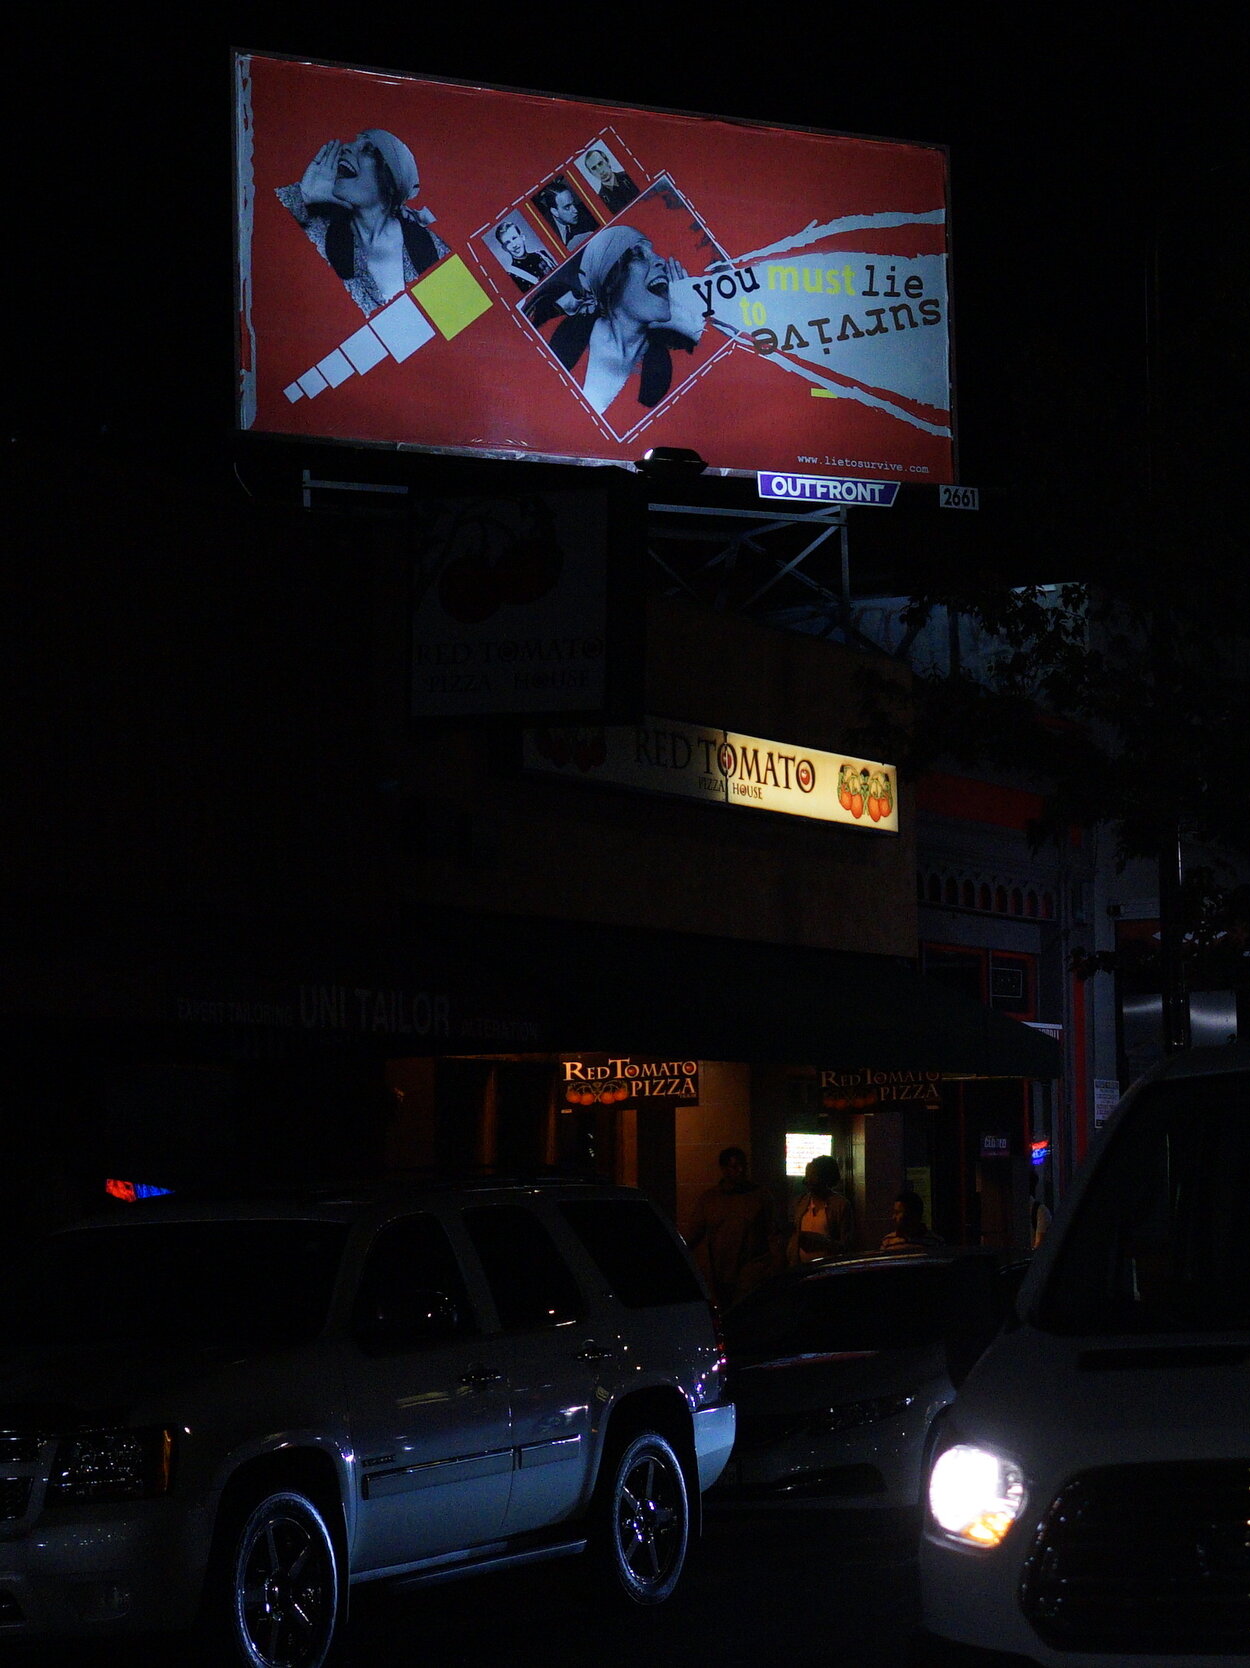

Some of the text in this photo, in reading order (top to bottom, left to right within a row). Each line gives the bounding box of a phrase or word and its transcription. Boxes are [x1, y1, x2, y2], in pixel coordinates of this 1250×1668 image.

[692, 264, 924, 317] you must lie
[739, 297, 942, 355] to survive
[797, 454, 930, 474] www.lietosurvive.com
[771, 476, 885, 503] OUTFRONT
[944, 487, 976, 507] 2661
[416, 637, 604, 666] RED TOMATO
[426, 670, 590, 693] PIZZA HOUSE
[634, 728, 816, 793] RED TOMATO
[698, 776, 763, 800] PIZZA HOUSE
[299, 983, 347, 1029] UNI
[354, 987, 450, 1037] TAILOR
[562, 1057, 697, 1081] RED TOMATO
[820, 1070, 861, 1088] RED
[630, 1077, 697, 1097] PIZZA
[880, 1083, 940, 1101] PIZZA
